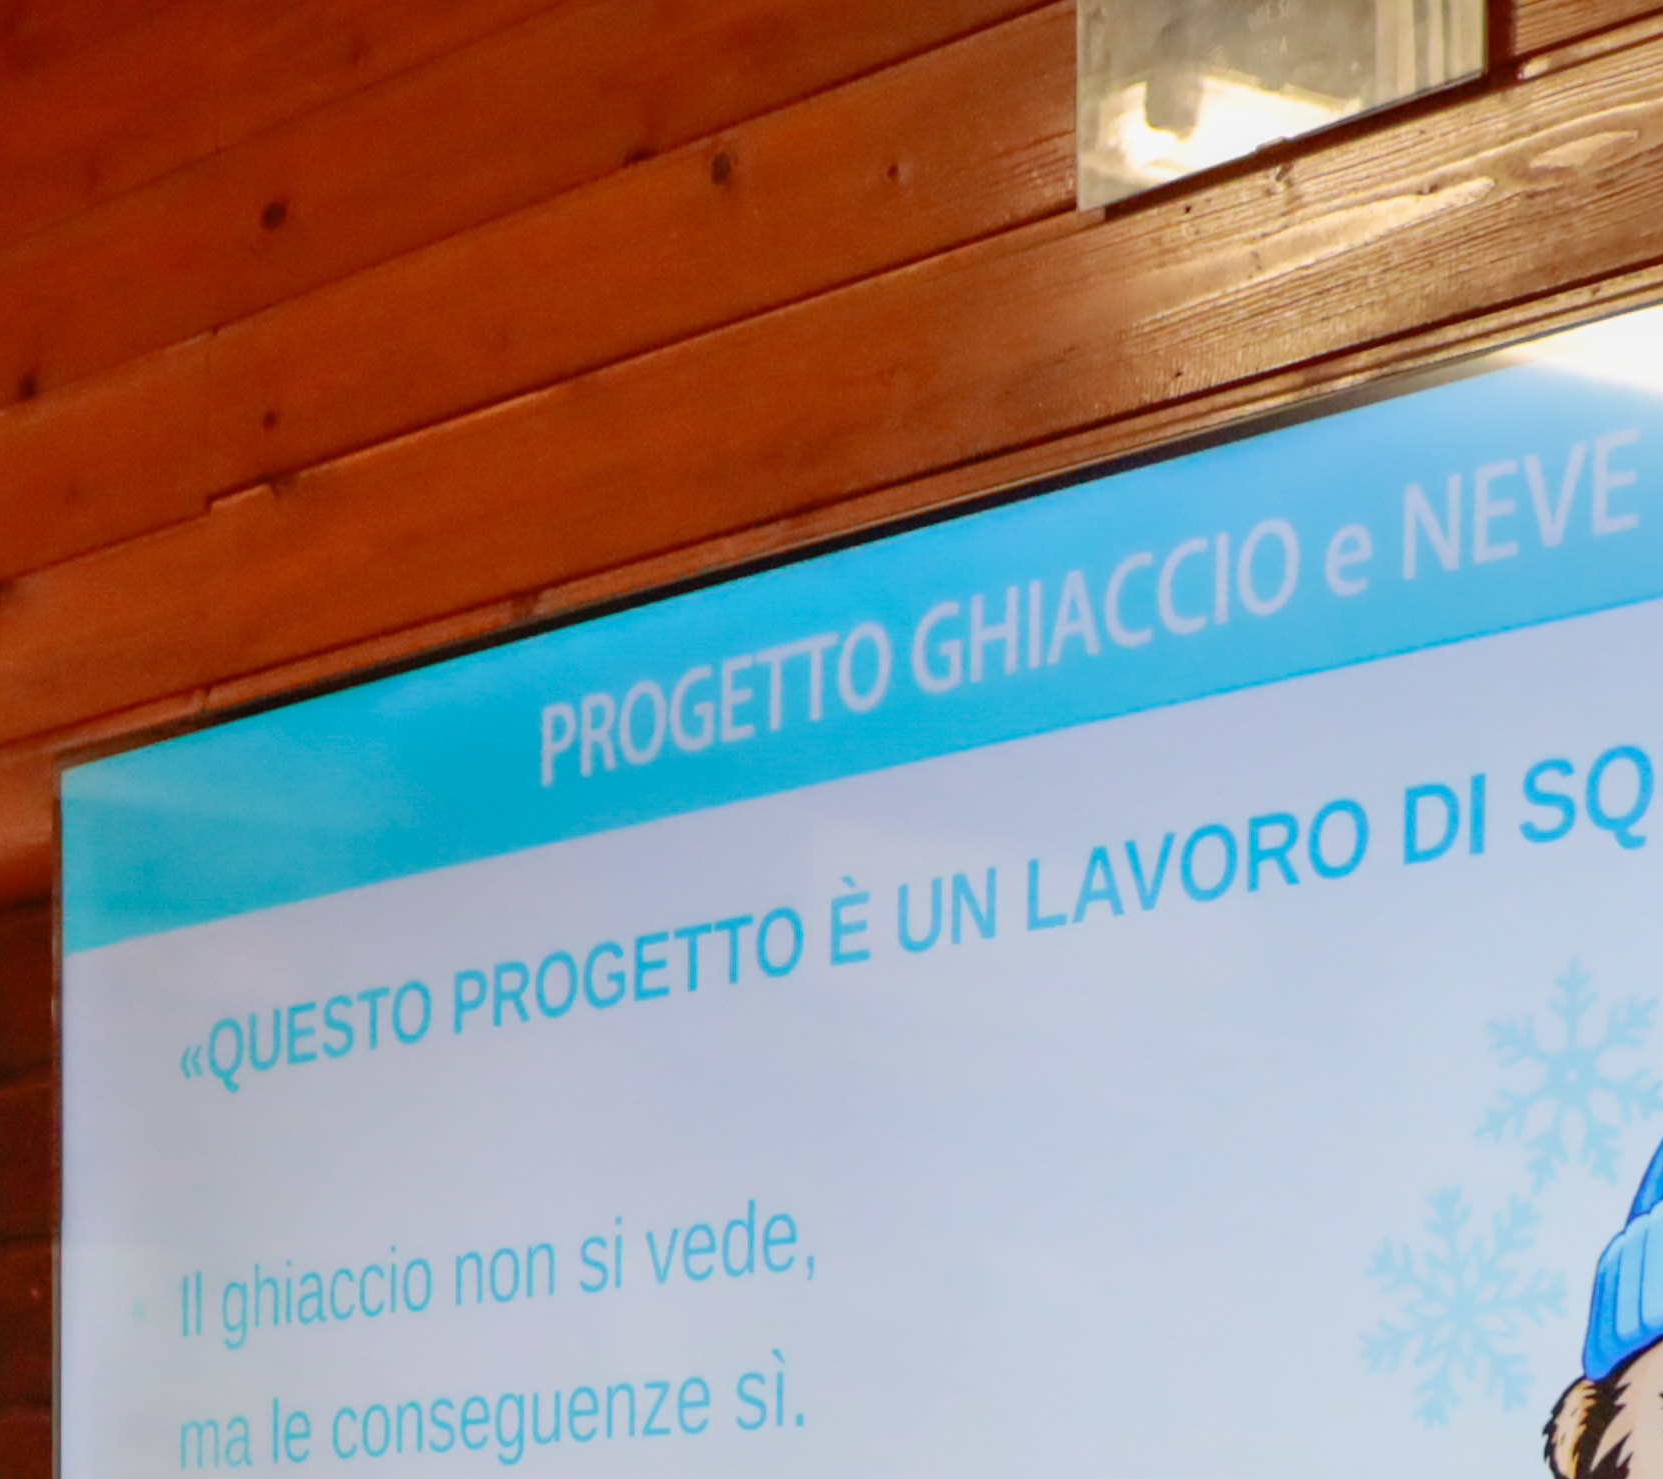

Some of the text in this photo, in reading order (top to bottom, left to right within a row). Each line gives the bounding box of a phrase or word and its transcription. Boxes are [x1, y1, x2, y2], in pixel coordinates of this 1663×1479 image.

[538, 430, 1642, 788] PROGETTO GHIACCIO e NEVE
[178, 977, 432, 1095] «QUESTO
[453, 906, 803, 1038] PROGETTO
[828, 877, 872, 965] È
[897, 869, 998, 953] UN
[1025, 797, 1370, 932] LAVORO
[1403, 772, 1487, 865] DI
[178, 1197, 819, 1351] Il ghiaccio non si vede,
[178, 1405, 253, 1473] ma
[269, 1393, 312, 1467] le
[734, 1347, 810, 1436] sì.
